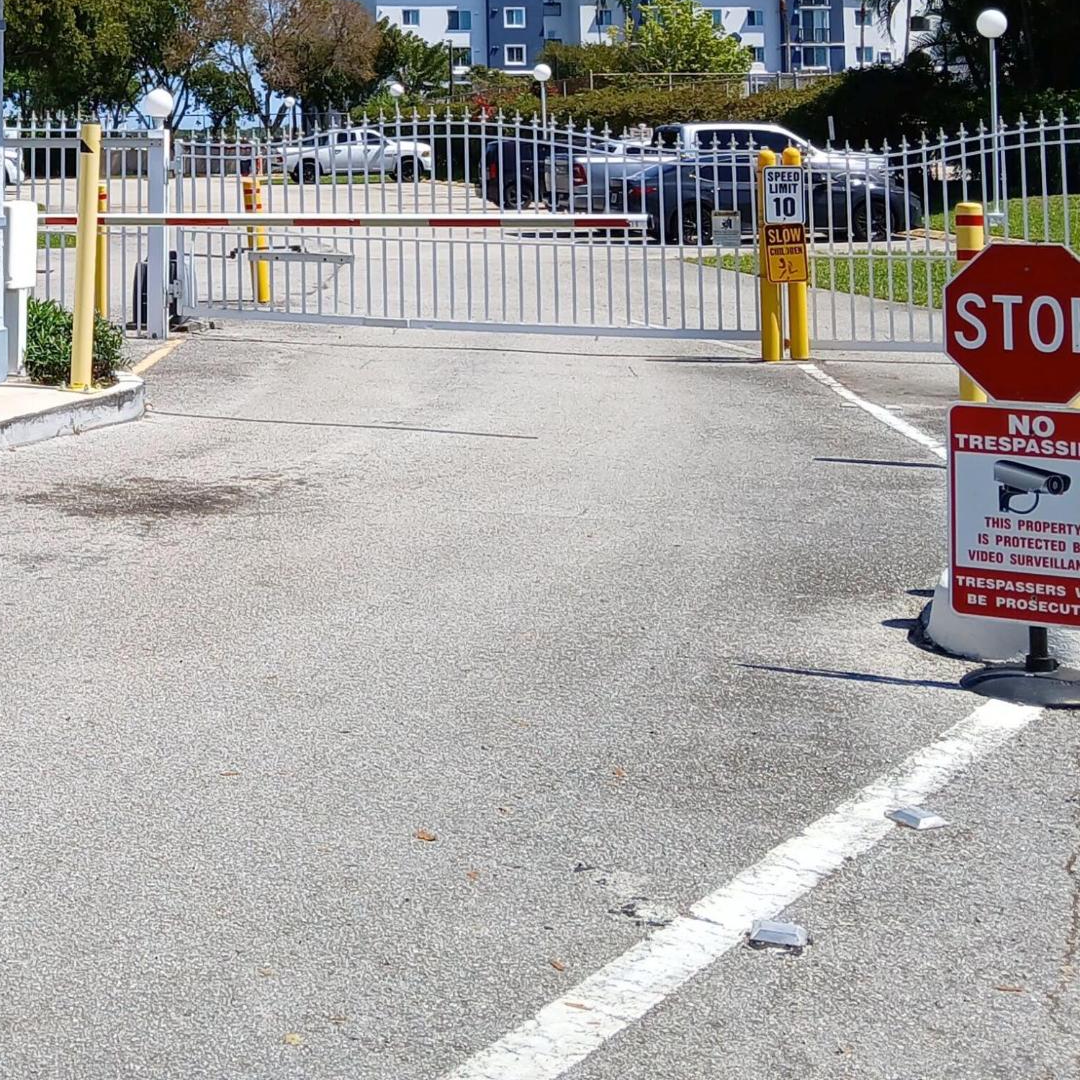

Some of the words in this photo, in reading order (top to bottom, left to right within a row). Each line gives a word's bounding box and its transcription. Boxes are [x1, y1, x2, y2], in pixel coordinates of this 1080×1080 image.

[767, 171, 800, 182] SPEED
[769, 183, 799, 194] LIMIT
[773, 197, 796, 217] 10
[768, 228, 801, 243] SLOW
[769, 246, 803, 256] CHILDREN
[1008, 414, 1055, 438] NO
[954, 433, 1080, 457] TRESPASSI
[984, 516, 1012, 530] THIS
[1017, 519, 1080, 536] PROPERTY
[978, 533, 989, 545] IS
[995, 535, 1066, 552] PROTECTED
[968, 549, 1004, 564] VIDEO
[956, 575, 1067, 597] TRESPASSERS
[967, 593, 987, 606] BE
